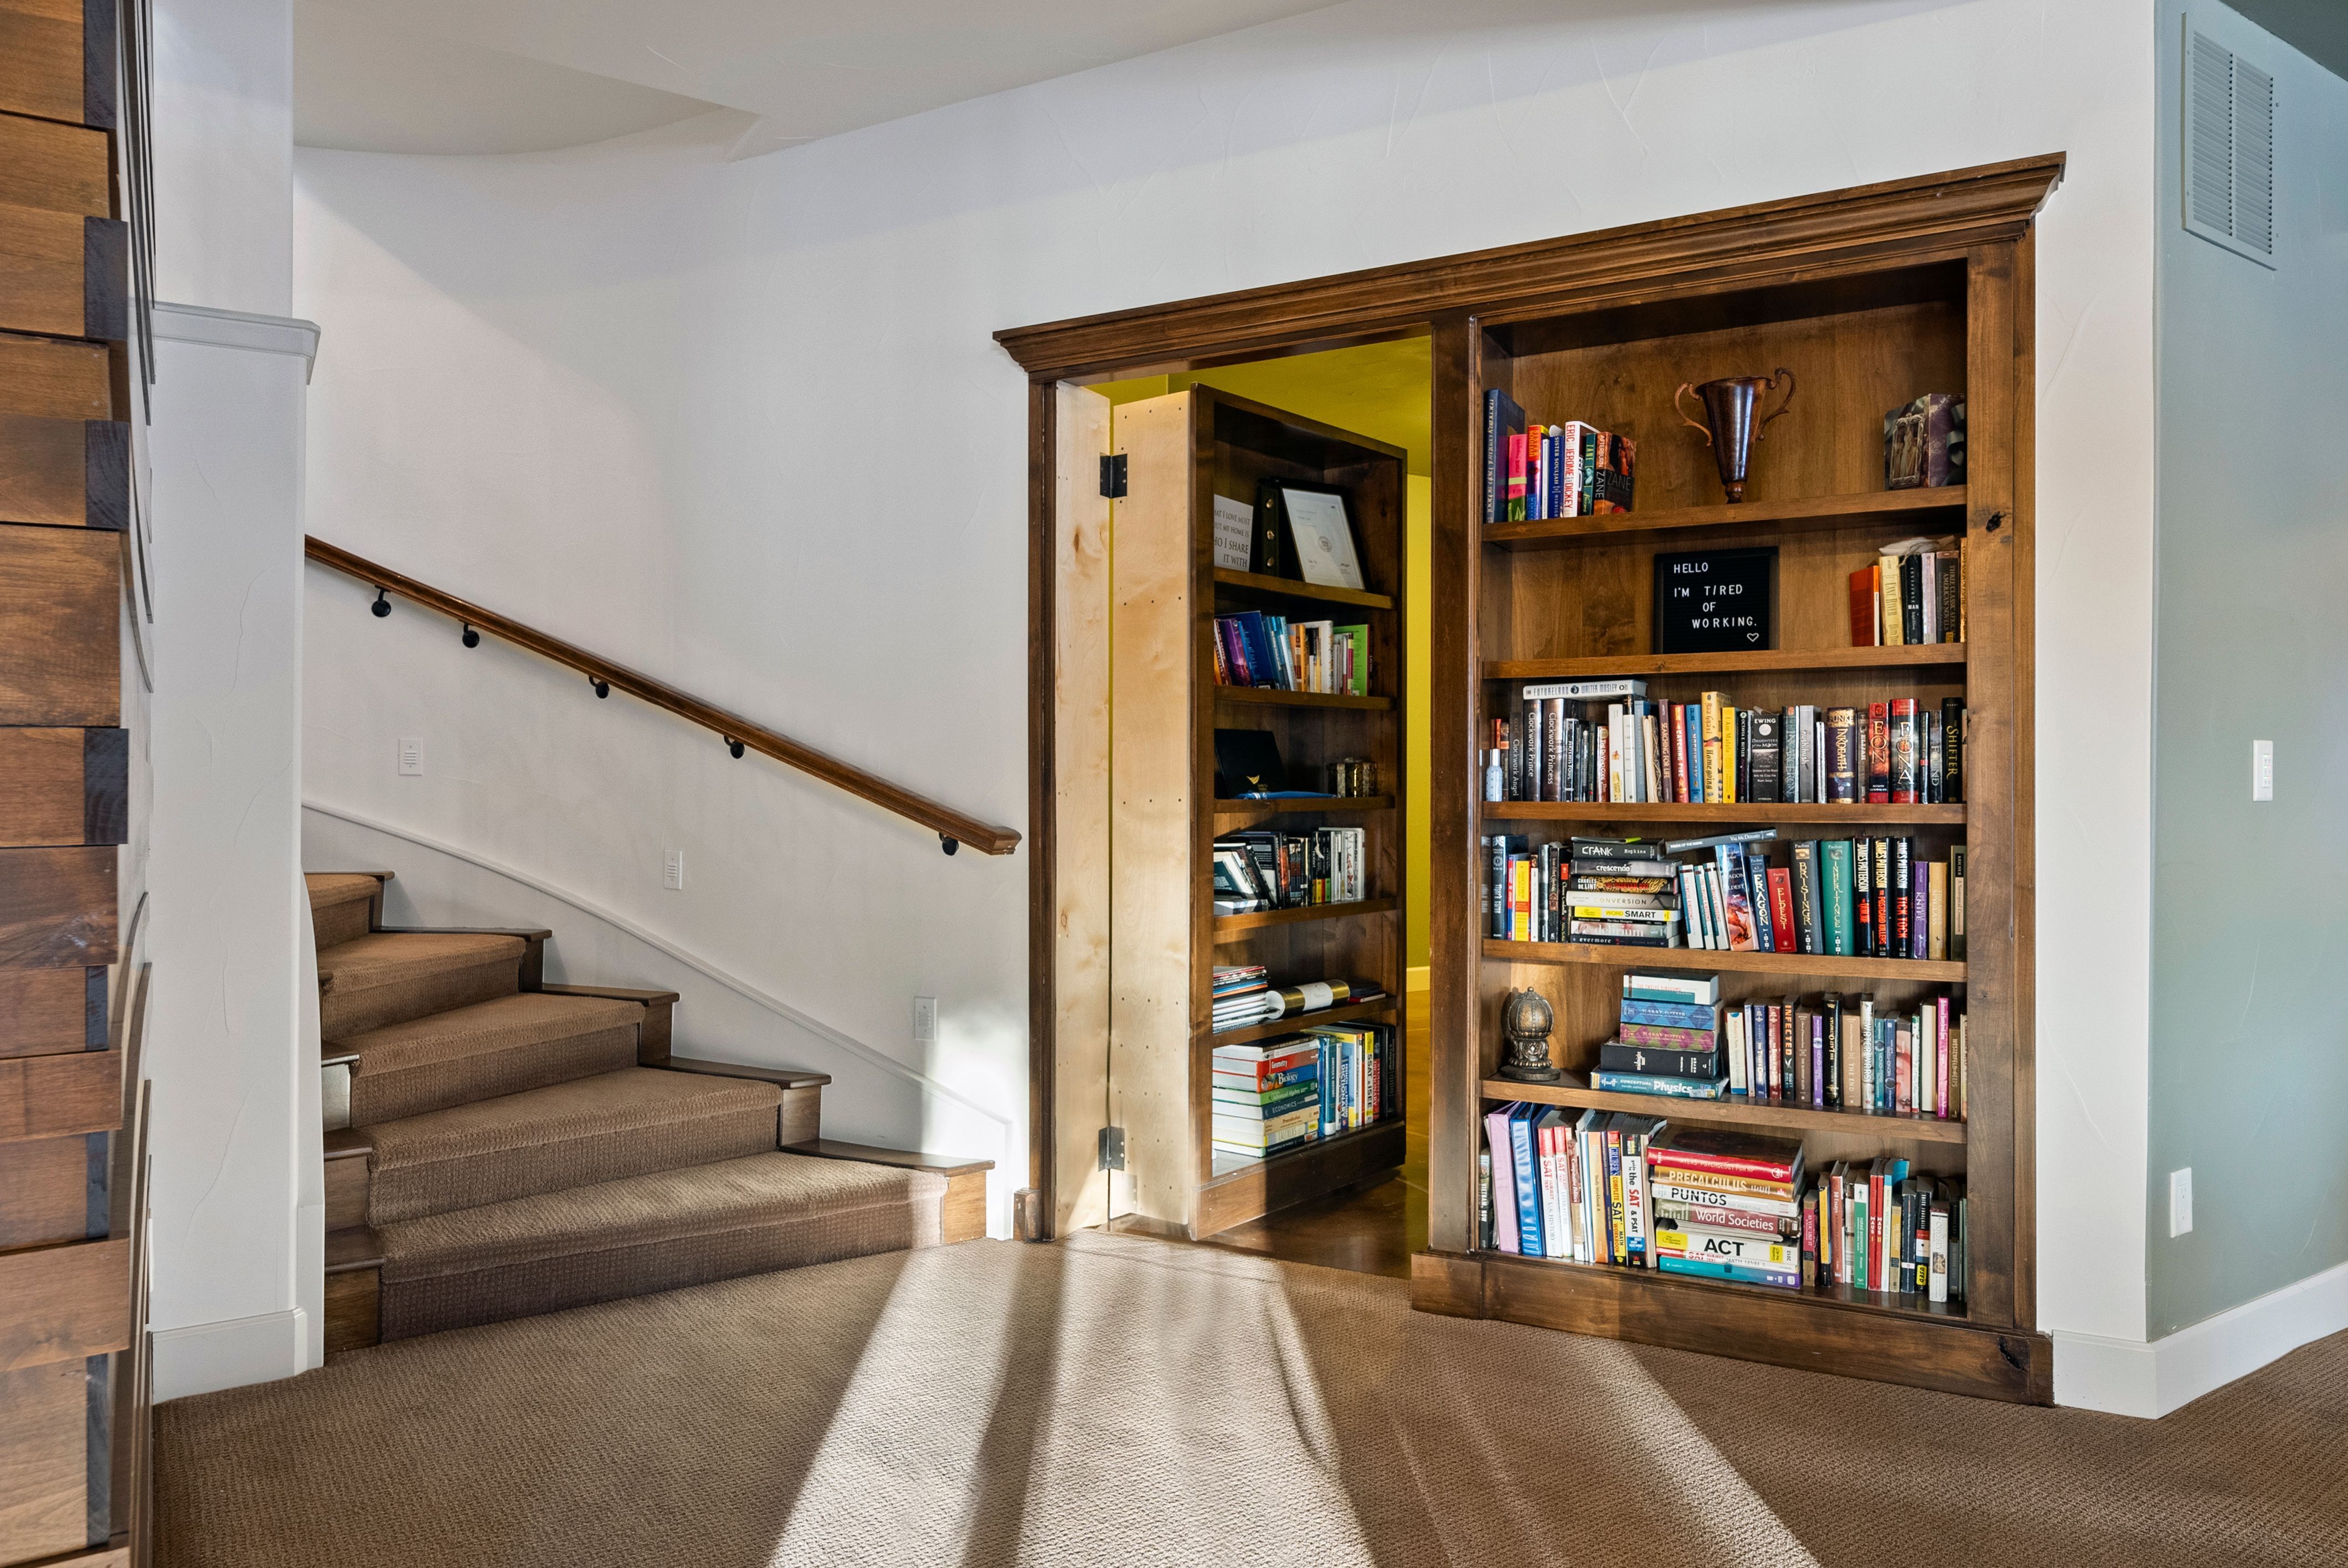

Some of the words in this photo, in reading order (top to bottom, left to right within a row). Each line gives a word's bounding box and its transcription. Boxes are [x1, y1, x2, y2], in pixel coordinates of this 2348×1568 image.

[1566, 424, 1575, 442] ERIC
[1585, 445, 1594, 460] ZANE
[1565, 448, 1574, 477] JEROME
[1595, 471, 1605, 498] ZANE
[1608, 471, 1631, 491] ZANE
[1564, 483, 1573, 509] DICKEY
[1226, 512, 1237, 522] LOVE
[1238, 517, 1250, 525] MOST
[1223, 524, 1229, 532] MY
[1230, 527, 1244, 537] HOME
[1224, 538, 1227, 548] I
[1229, 540, 1249, 554] SHARE
[1223, 554, 1229, 563] IT
[1231, 555, 1247, 568] WITH
[1674, 562, 1708, 574] HELLO
[1674, 587, 1690, 597] I'M
[1704, 584, 1743, 596] TIRED
[1885, 582, 1897, 598] CANE
[1702, 602, 1716, 612] OF
[1886, 599, 1898, 616] RIVER
[1692, 616, 1757, 628] WORKING.
[1533, 687, 1568, 696] FUTURELAND
[1581, 685, 1598, 694] WALTER
[1599, 684, 1617, 692] MOSLEY
[1528, 712, 1536, 752] Clockwork
[1548, 712, 1557, 753] Clockwork
[1836, 728, 1848, 772] INKDEATH
[1870, 721, 1888, 764] EON
[1897, 722, 1914, 785] EONA
[1947, 725, 1959, 780] SHIFTER
[1547, 754, 1556, 785] Princess
[1786, 730, 1795, 795] INCARCERON
[1931, 745, 1939, 786] FOUND
[1511, 776, 1519, 796] Angel
[1857, 843, 1868, 861] JAMES
[1876, 840, 1887, 859] JAMES
[1897, 841, 1908, 859] JAMES
[1596, 863, 1630, 871] crescendo
[1876, 859, 1887, 889] PATTERSON
[1897, 859, 1908, 889] PATTERSON
[1857, 862, 1869, 892] PATTERSON
[1753, 874, 1769, 926] ERAGON
[1799, 862, 1811, 926] BRISINGR
[1832, 861, 1843, 928] INHERITANCE
[1777, 888, 1788, 930] ELDEST
[1897, 896, 1908, 915] TICK
[1594, 925, 1644, 936] delirium
[1897, 917, 1908, 938] TOCK
[1863, 1023, 1872, 1053] WATER
[1271, 1060, 1288, 1069] Geometry
[1863, 1055, 1872, 1081] WARS
[1278, 1072, 1299, 1084] Biology
[1653, 1080, 1693, 1094] Physics
[1272, 1101, 1297, 1113] ECONOMICS
[1544, 1160, 1552, 1179] SAT
[1610, 1147, 1620, 1176] GRUBER'S
[1699, 1159, 1735, 1171] PSYCHOLOGY
[1669, 1170, 1747, 1192] PRECALCULUS
[1629, 1189, 1640, 1207] SAT
[1671, 1188, 1727, 1205] PUNTOS
[1612, 1202, 1622, 1222] SAT
[1696, 1209, 1726, 1224] World
[1728, 1214, 1774, 1231] Societies
[1704, 1238, 1744, 1256] ACT
